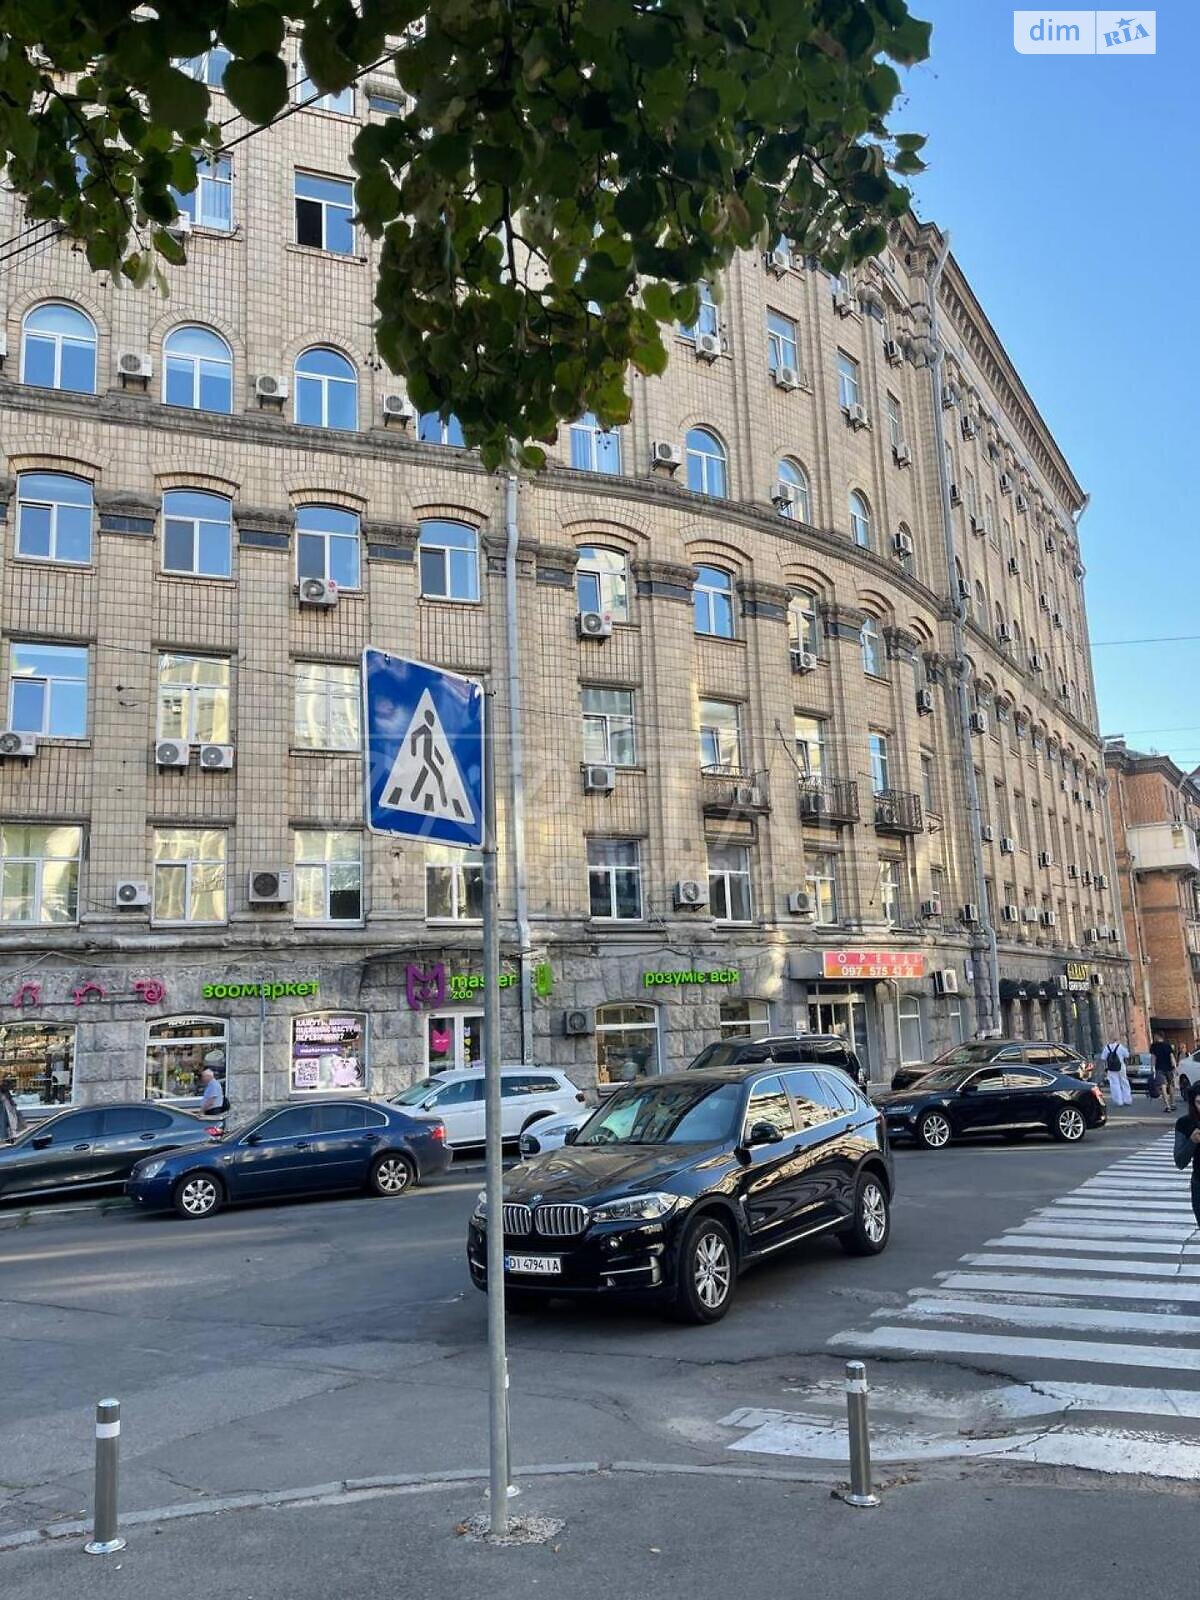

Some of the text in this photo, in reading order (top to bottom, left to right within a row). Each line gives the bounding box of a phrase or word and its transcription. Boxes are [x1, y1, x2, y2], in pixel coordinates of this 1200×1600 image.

[841, 965, 864, 977] 097
[450, 974, 517, 988] maser
[644, 969, 740, 988] розуміє всіх
[203, 981, 320, 999] зоомаркет
[452, 989, 474, 1000] zoo
[523, 1259, 543, 1270] 4794
